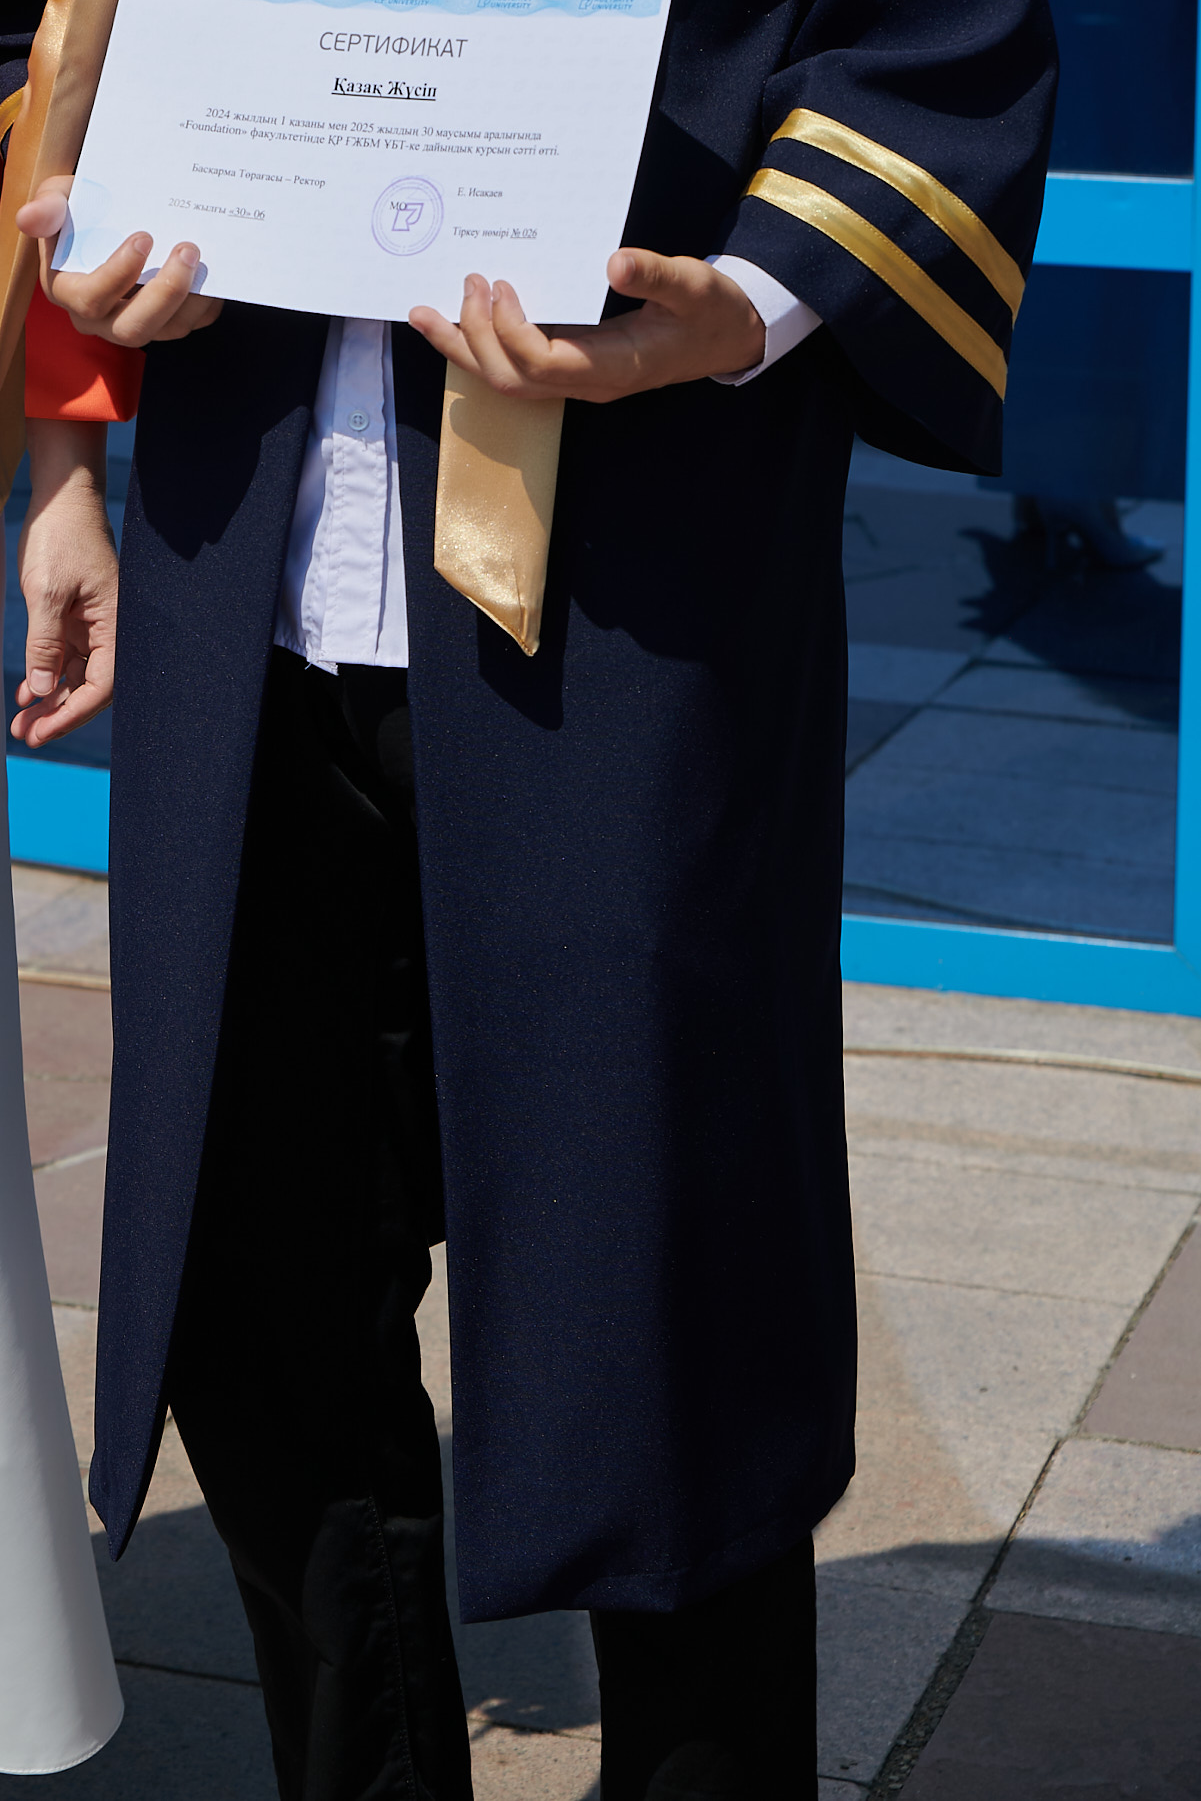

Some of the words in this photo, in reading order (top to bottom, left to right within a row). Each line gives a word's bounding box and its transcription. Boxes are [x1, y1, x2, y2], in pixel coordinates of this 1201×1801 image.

[490, 1, 531, 9] UNIVERSITY
[319, 32, 468, 58] СЕРТИФИКАТ
[333, 77, 383, 97] Қазақ
[388, 81, 438, 99] Жүсіп
[206, 107, 231, 120] 2024
[281, 116, 286, 126] 1
[328, 122, 348, 132] мен
[350, 121, 374, 133] 2025
[421, 126, 434, 137] 30
[436, 129, 481, 140] маусымы
[179, 119, 247, 136] «Foundation»
[250, 128, 325, 144] факультетінде
[475, 145, 511, 157] курсын
[293, 175, 326, 188] Ректор
[457, 187, 466, 197] Е.
[168, 198, 191, 210] 2025
[253, 209, 266, 220] 06
[522, 228, 538, 238] 026
